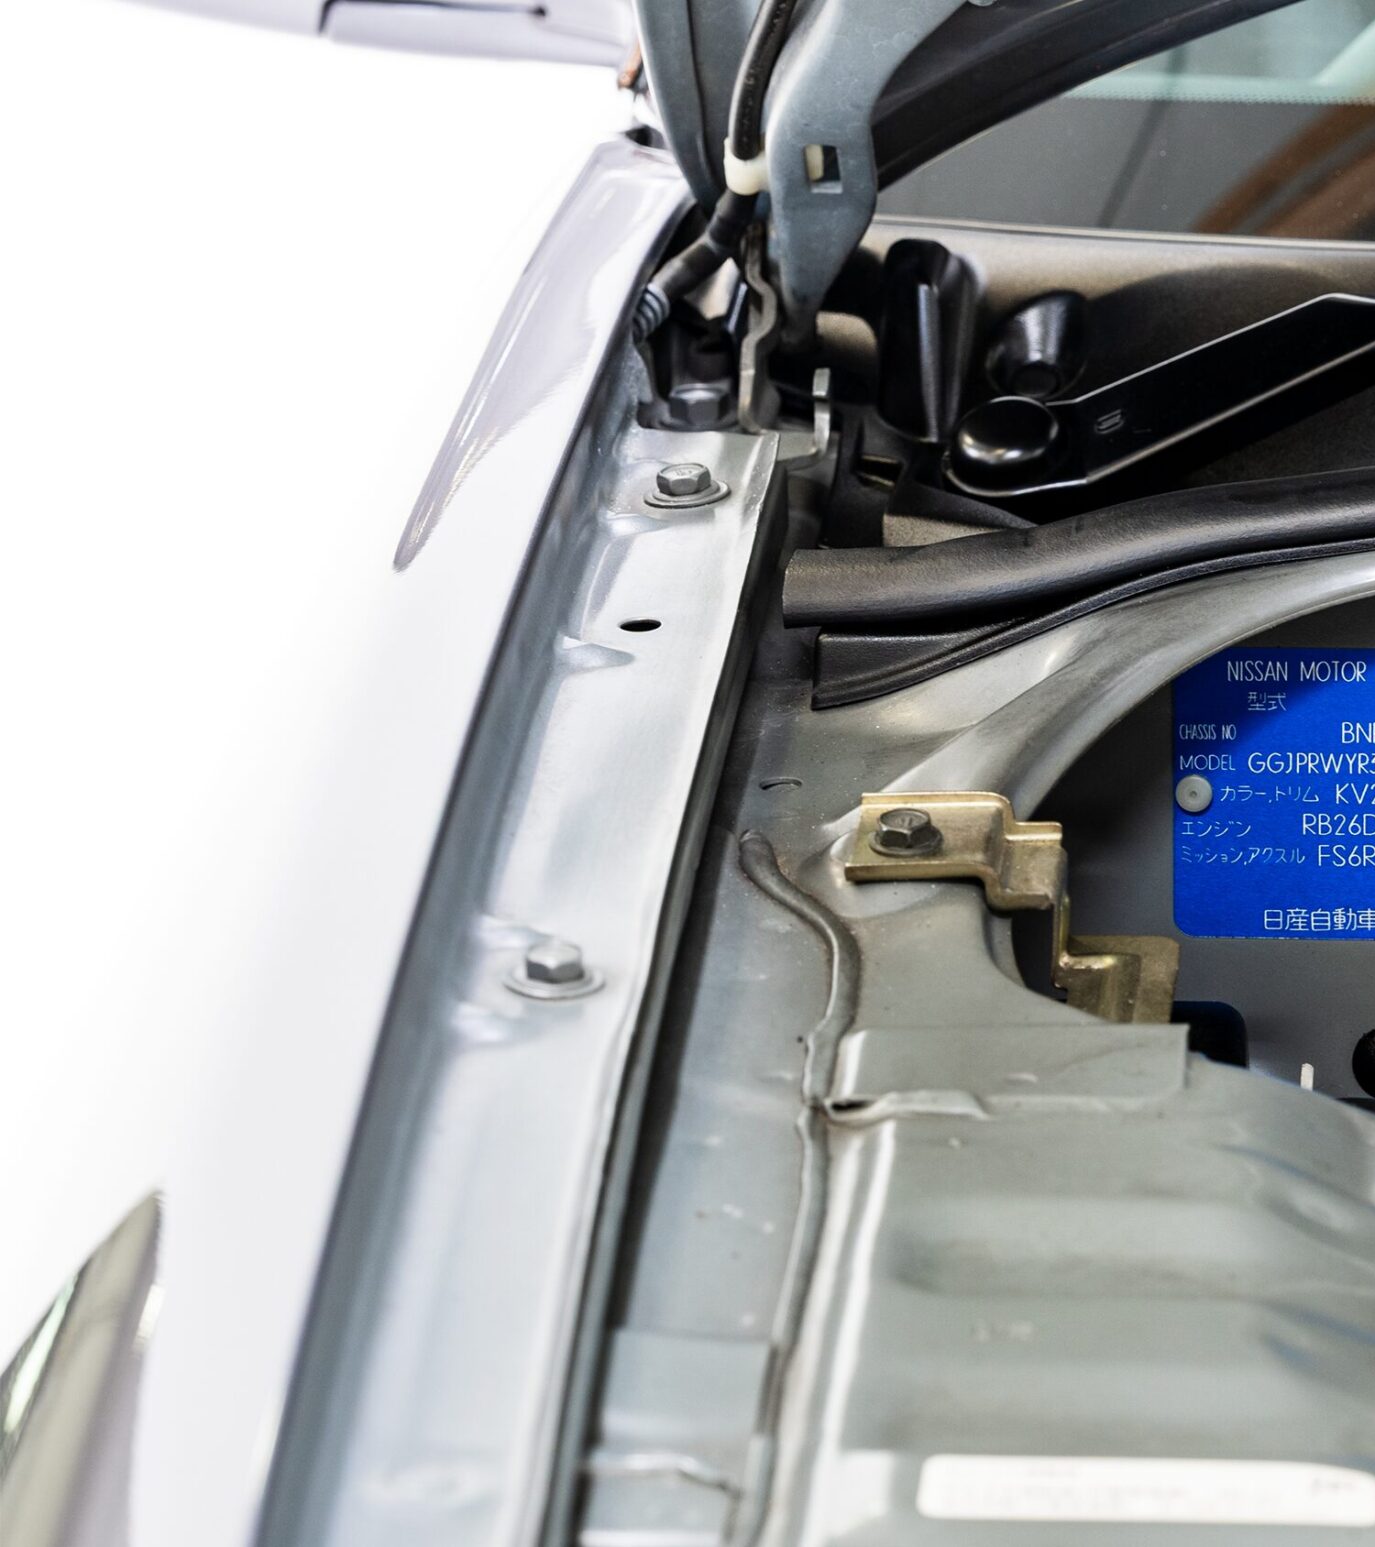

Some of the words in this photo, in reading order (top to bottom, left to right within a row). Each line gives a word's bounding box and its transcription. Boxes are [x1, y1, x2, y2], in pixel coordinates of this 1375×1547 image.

[1227, 660, 1288, 682] NISSAN
[1300, 660, 1367, 682] MOTOR
[1248, 692, 1287, 711] 型式
[1180, 723, 1217, 740] CHASSIS
[1221, 724, 1237, 740] NO
[1180, 754, 1236, 771] MODEL
[1181, 820, 1251, 837] エンジン
